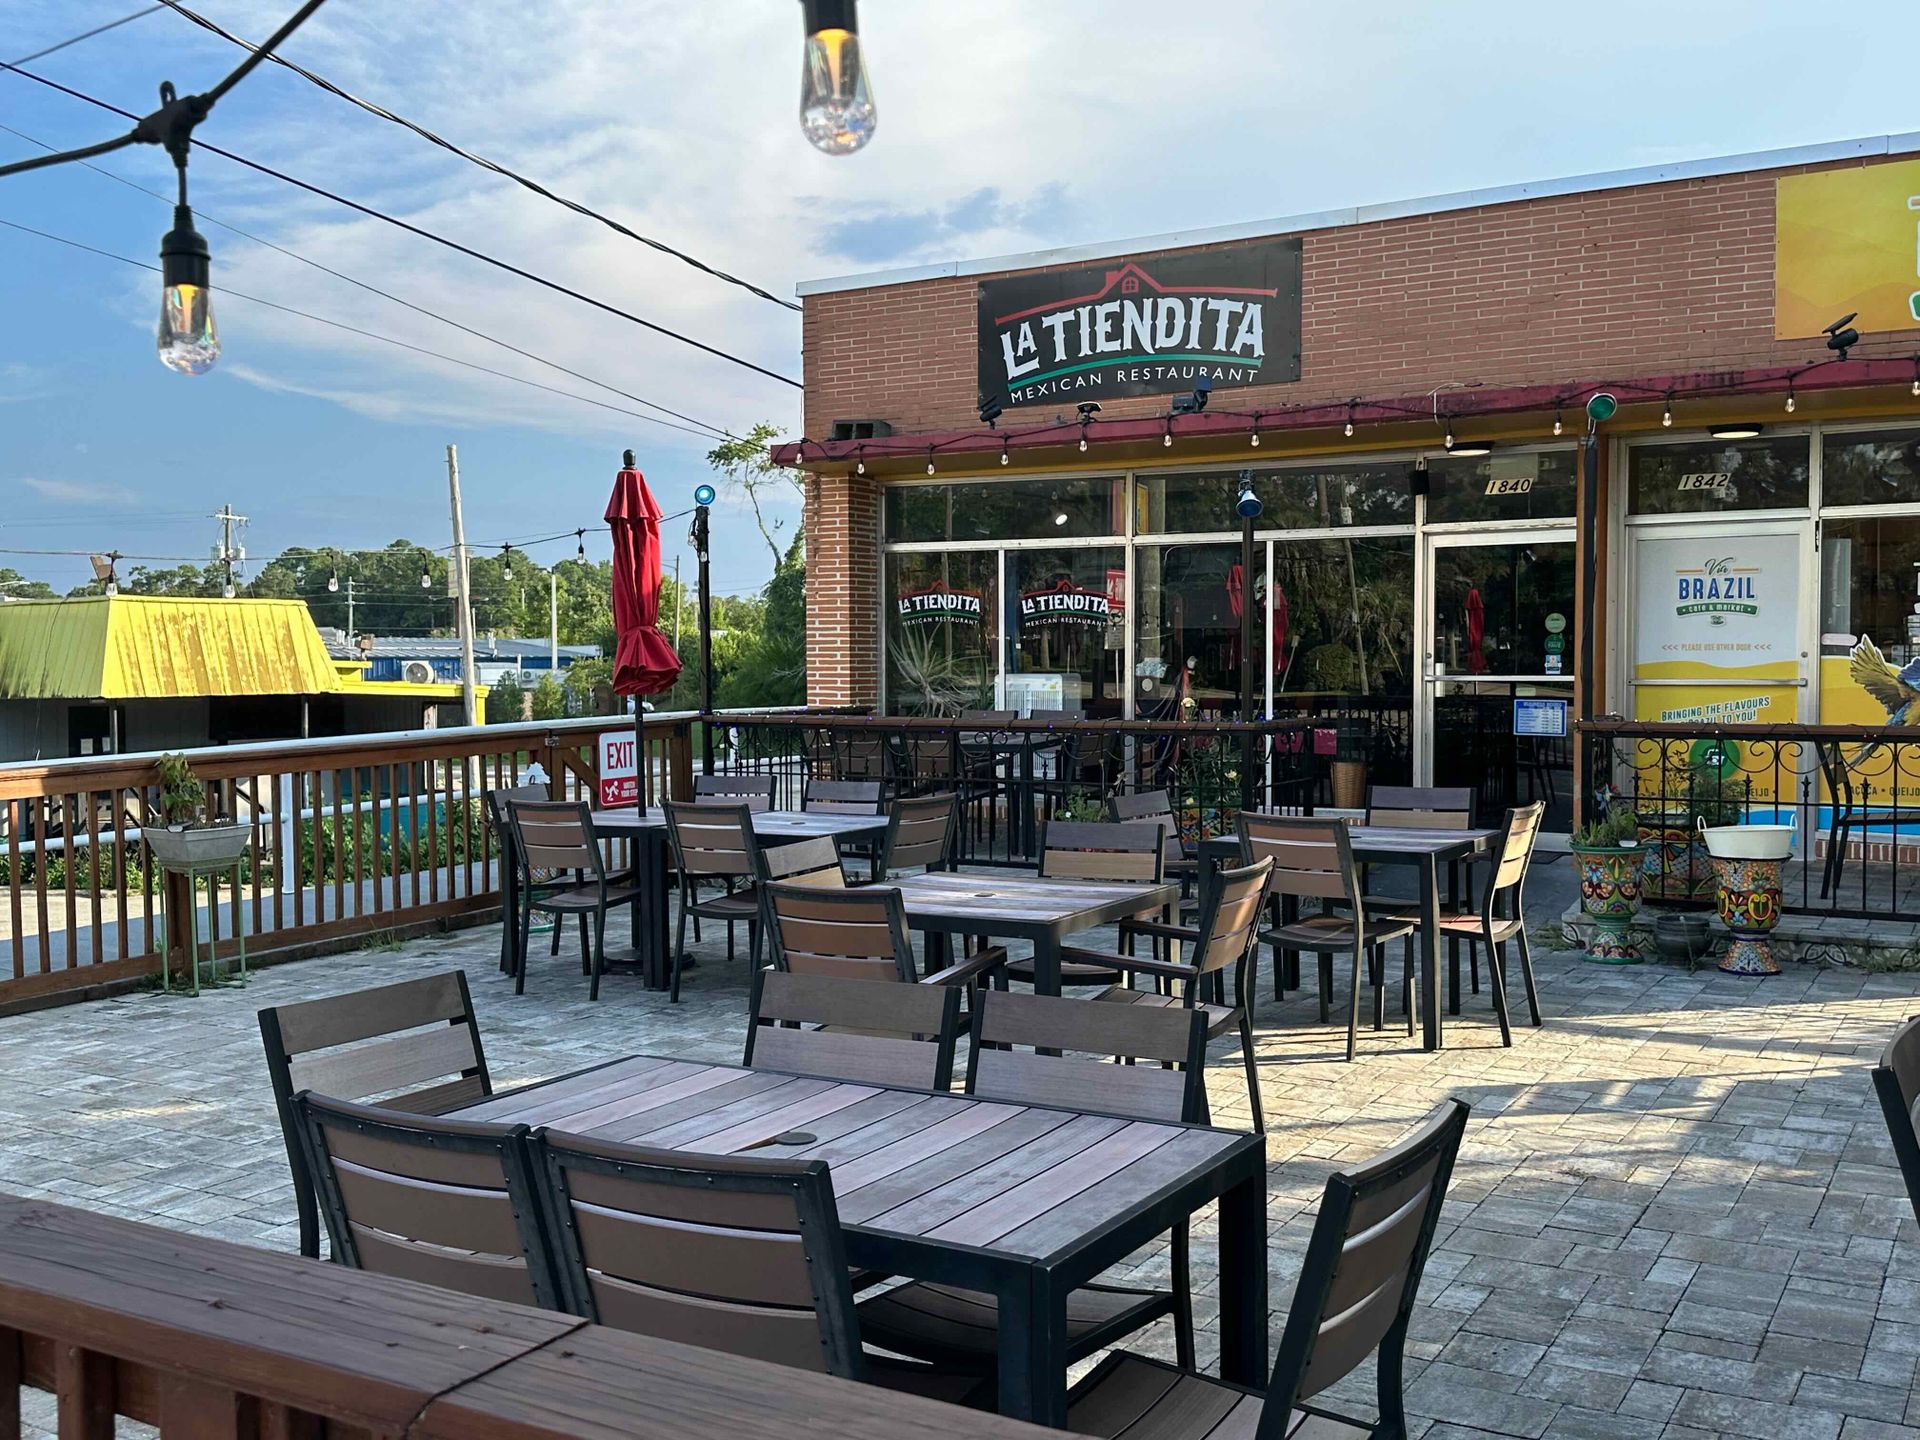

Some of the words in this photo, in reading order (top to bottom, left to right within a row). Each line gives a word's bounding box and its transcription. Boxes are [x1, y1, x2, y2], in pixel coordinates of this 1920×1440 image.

[1000, 321, 1040, 381] LA
[1041, 297, 1265, 363] TIENDITA
[1010, 372, 1102, 404] MEXICAN
[1117, 366, 1258, 383] RESTAURANT
[1489, 479, 1531, 494] 1840
[1683, 474, 1728, 489] 1842
[1704, 557, 1734, 575] Via
[1679, 577, 1755, 600] BRAZIL
[898, 598, 912, 614] LA
[912, 594, 981, 613] TIENDITA
[1021, 598, 1036, 614] LA
[1036, 594, 1109, 614] TIENDITA
[902, 616, 933, 628] MEXICAN
[935, 616, 979, 626] RESTAURANT
[1025, 618, 1058, 628] MEXICAN
[1060, 617, 1106, 627] RESTAURANT
[1661, 707, 1702, 722] BRINGING
[1705, 704, 1721, 714] THE
[1724, 697, 1770, 712] FLAVOURS
[1721, 714, 1732, 724] TO
[1735, 710, 1756, 722] YOU!
[607, 741, 634, 770] EXIT
